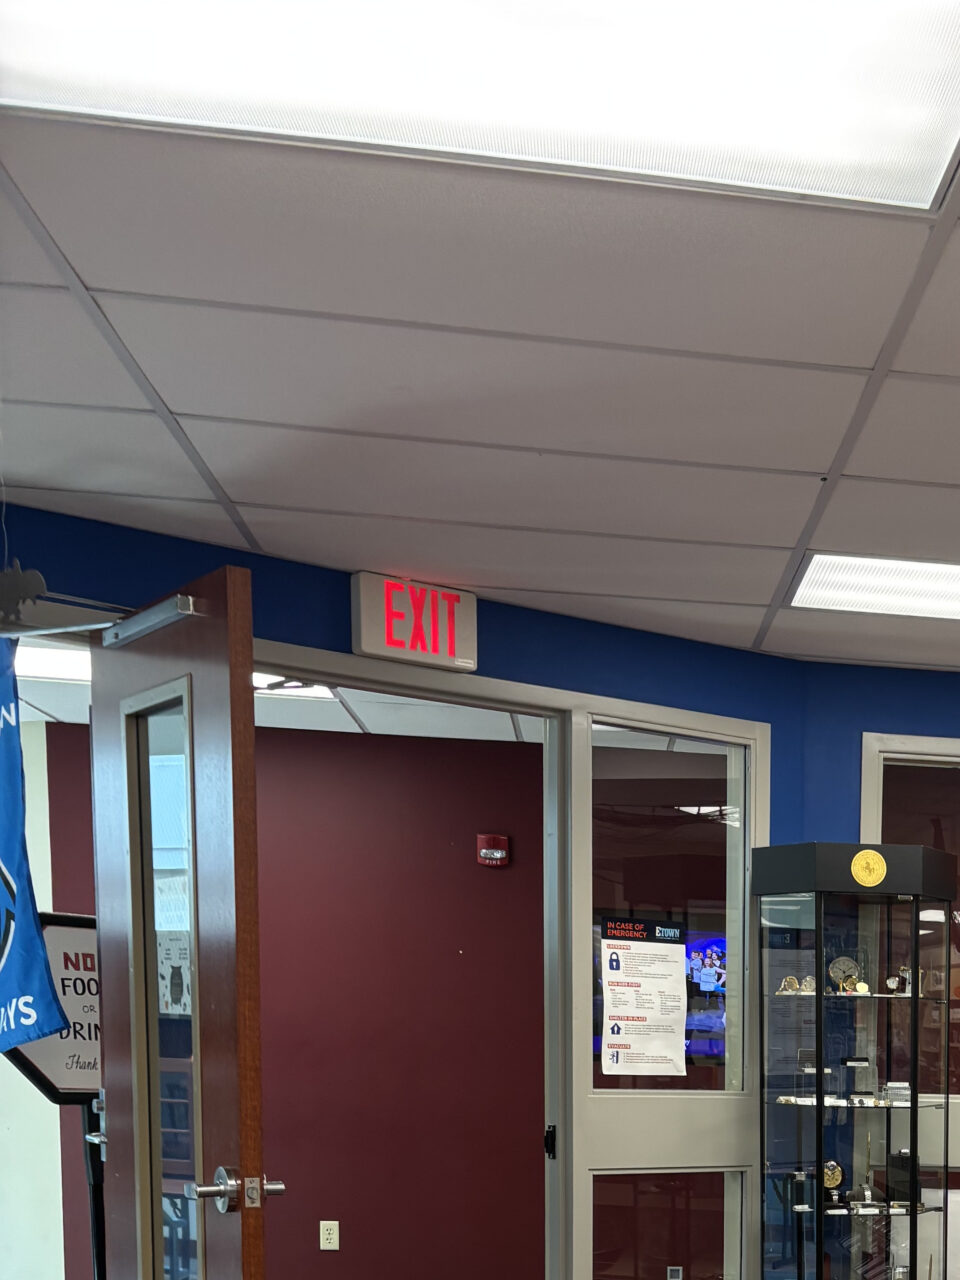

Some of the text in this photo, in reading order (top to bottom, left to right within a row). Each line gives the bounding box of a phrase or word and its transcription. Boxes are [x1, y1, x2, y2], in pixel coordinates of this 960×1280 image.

[384, 579, 460, 658] EXIT
[607, 921, 645, 931] IN CASE OF
[607, 929, 647, 938] EMERGENCY
[63, 952, 96, 972] NO
[60, 977, 100, 997] FOO
[82, 1004, 97, 1014] OR
[59, 1021, 100, 1041] DRIN
[65, 1053, 98, 1071] Thank
